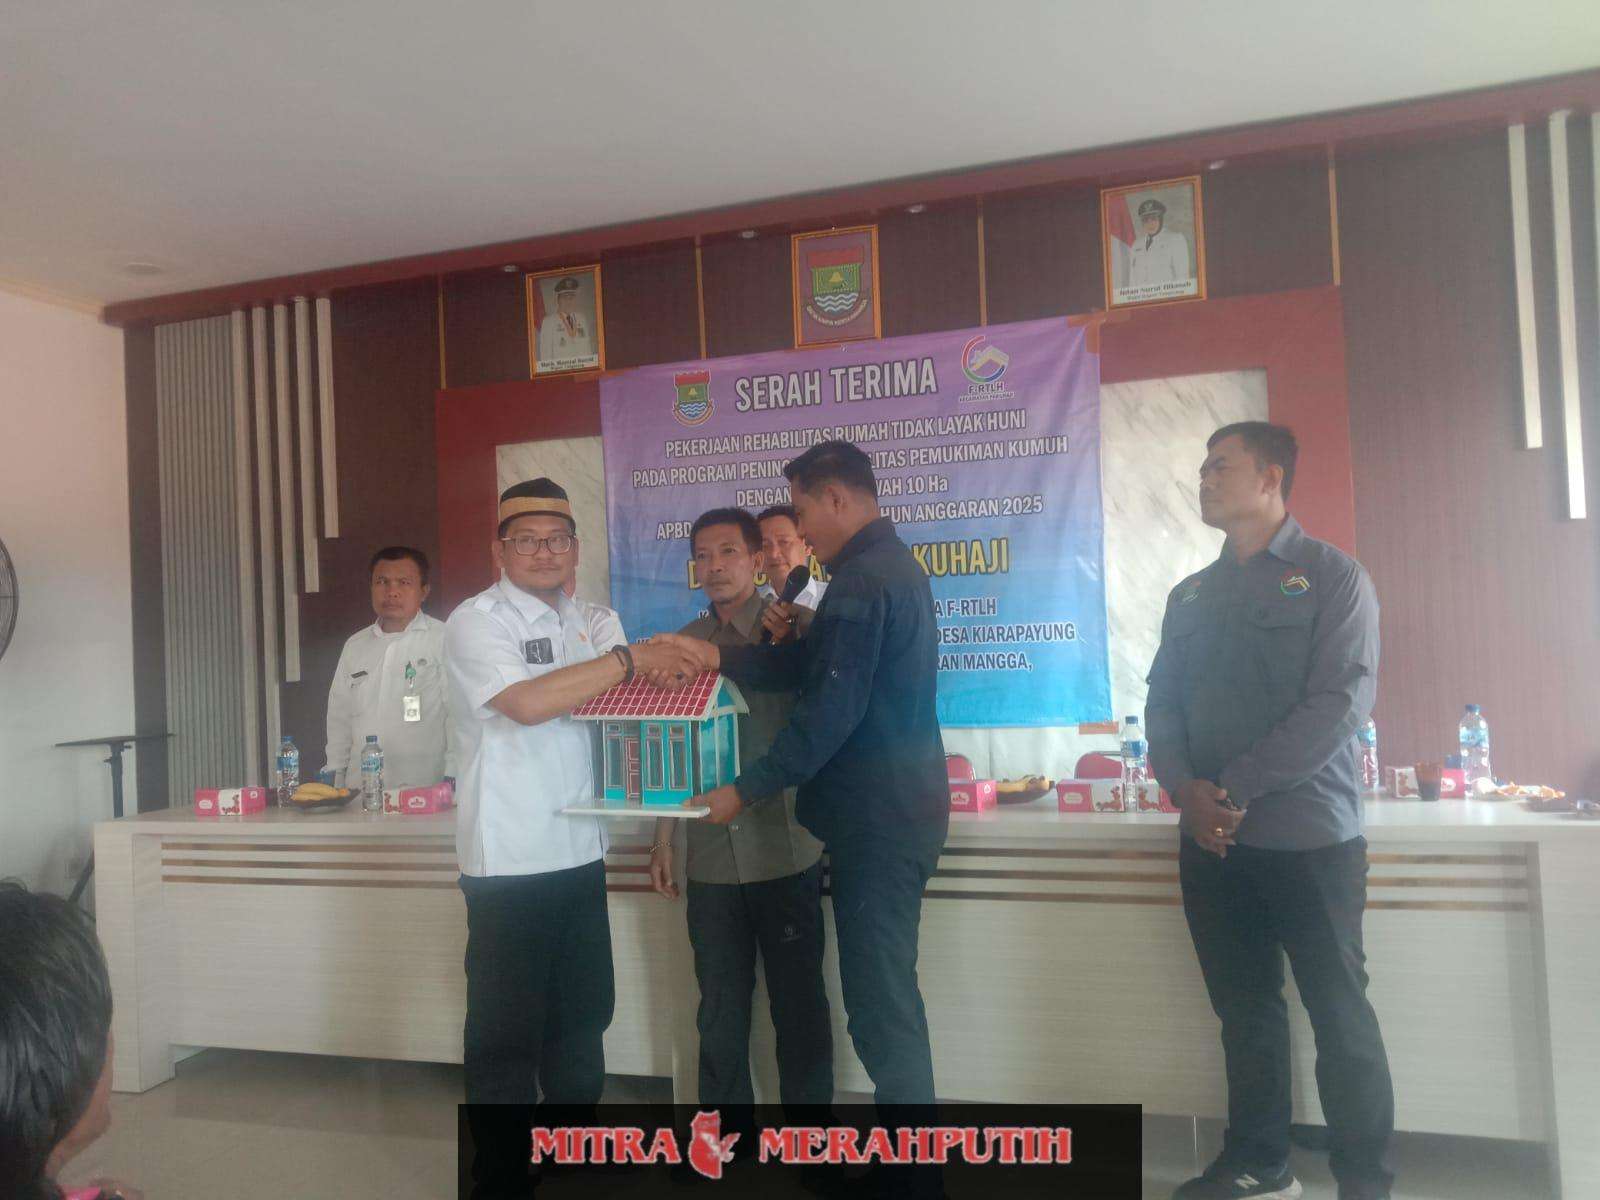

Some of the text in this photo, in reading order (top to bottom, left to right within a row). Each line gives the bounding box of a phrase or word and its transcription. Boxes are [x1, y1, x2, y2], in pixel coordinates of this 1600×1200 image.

[735, 356, 939, 413] SERAH TERIMA
[665, 408, 1027, 459] PEKERJAAN REHABILITAS RUMAH TIDAK LAYAK HUNI
[632, 468, 669, 488] PADA
[669, 463, 738, 486] PROGRAM
[909, 442, 1005, 467] PEMUKIMAN
[1007, 435, 1069, 458] KUMUH
[736, 485, 793, 507] DENGAN
[906, 476, 925, 495] 10
[927, 474, 949, 493] Ha
[656, 520, 693, 540] APBD
[913, 498, 1000, 523] ANGGARAN
[1001, 495, 1044, 517] 2025
[911, 537, 1010, 577] KUHAJI
[946, 598, 997, 617] F-RTLH
[971, 623, 1076, 645] KIARAPAYUNG
[962, 652, 1033, 672] MANGGA,
